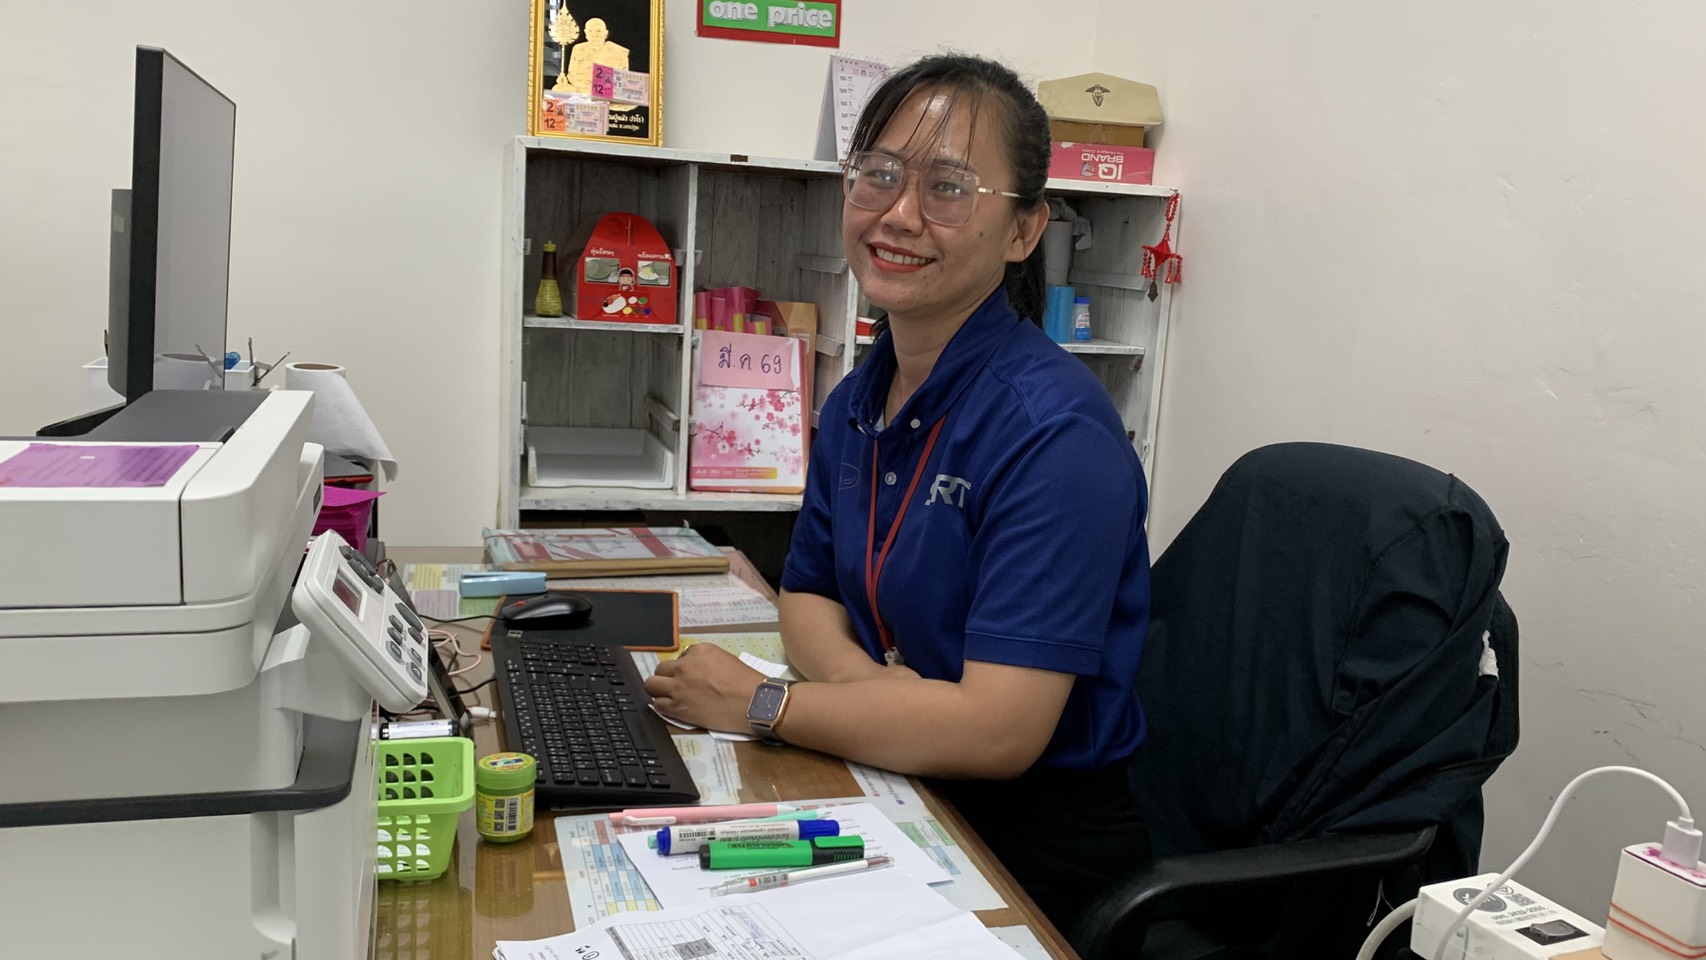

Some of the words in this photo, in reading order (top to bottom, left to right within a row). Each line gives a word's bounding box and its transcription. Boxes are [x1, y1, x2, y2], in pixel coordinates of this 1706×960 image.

[708, 0, 758, 20] one
[767, 2, 833, 29] price
[595, 67, 604, 79] 2
[593, 83, 604, 95] 12
[546, 101, 554, 113] 2
[544, 117, 556, 129] 12
[1081, 153, 1124, 163] BRAND
[1098, 163, 1123, 180] IQ
[760, 353, 782, 375] 69
